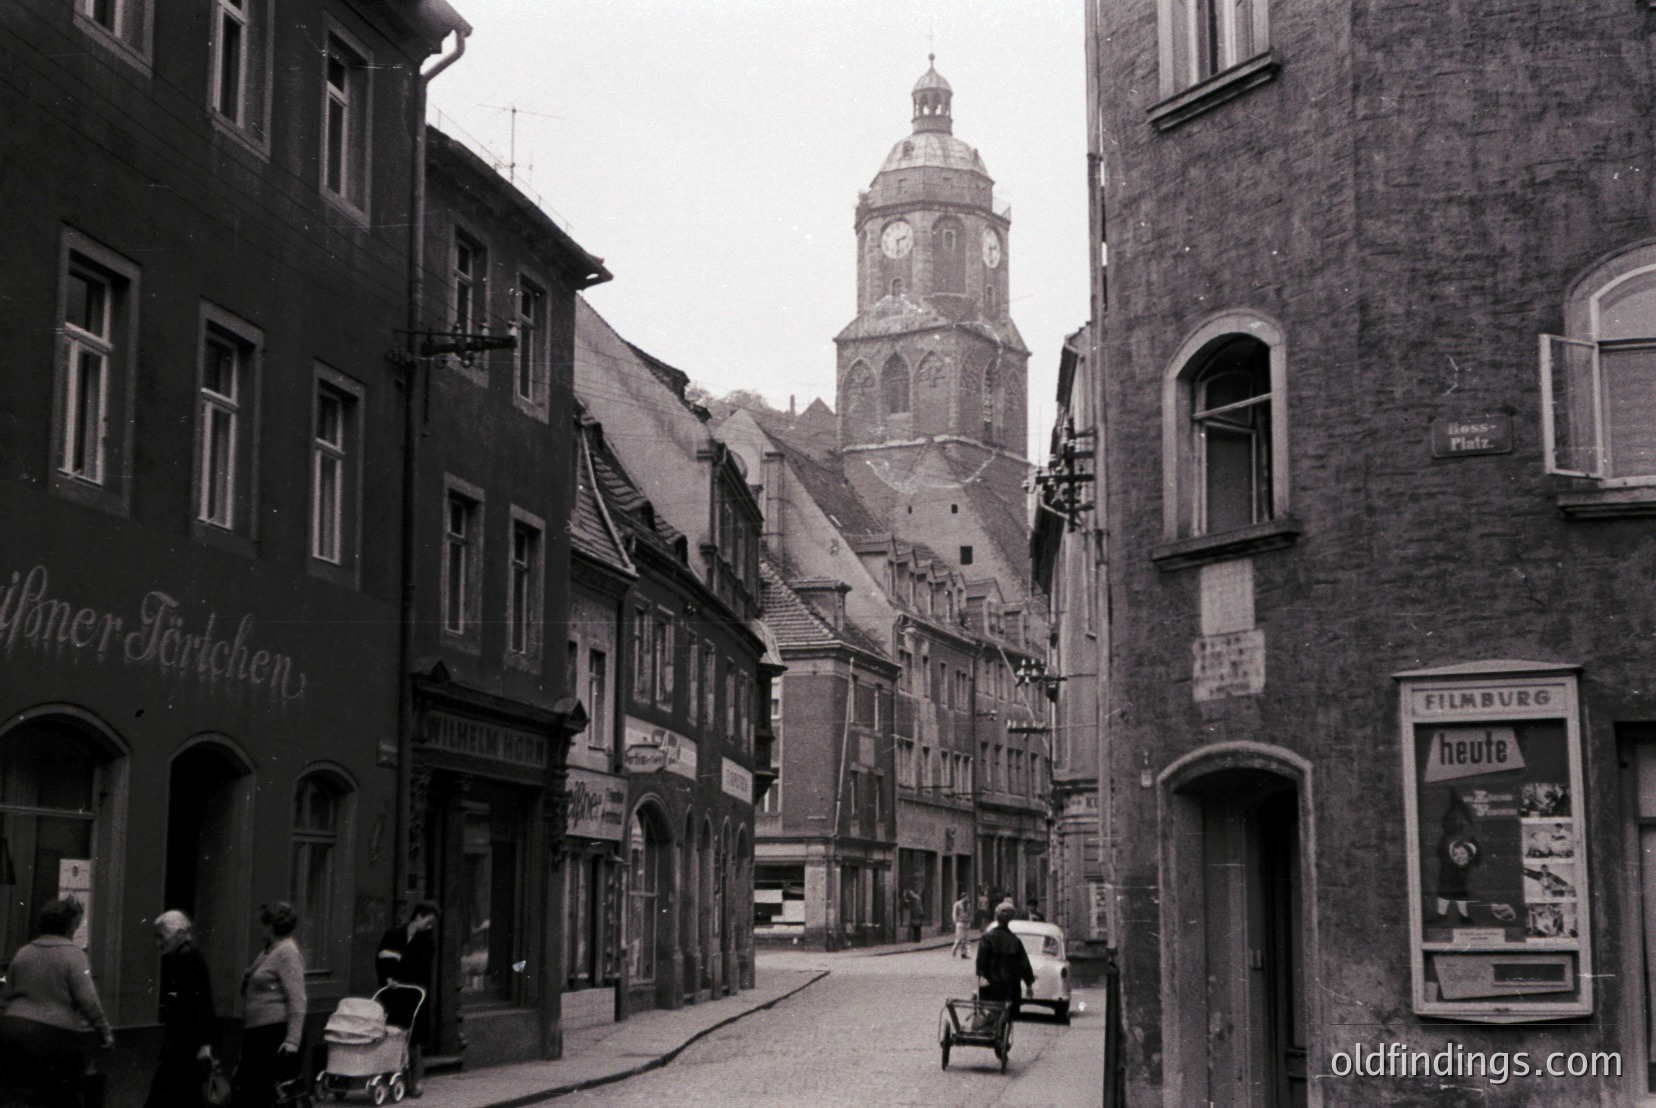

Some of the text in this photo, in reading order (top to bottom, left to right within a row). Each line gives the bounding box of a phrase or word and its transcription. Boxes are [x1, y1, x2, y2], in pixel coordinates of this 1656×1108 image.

[0, 565, 123, 655] ißner
[1425, 690, 1551, 710] FILMBURG
[428, 715, 499, 757] WILHELM
[1439, 731, 1508, 765] heute
